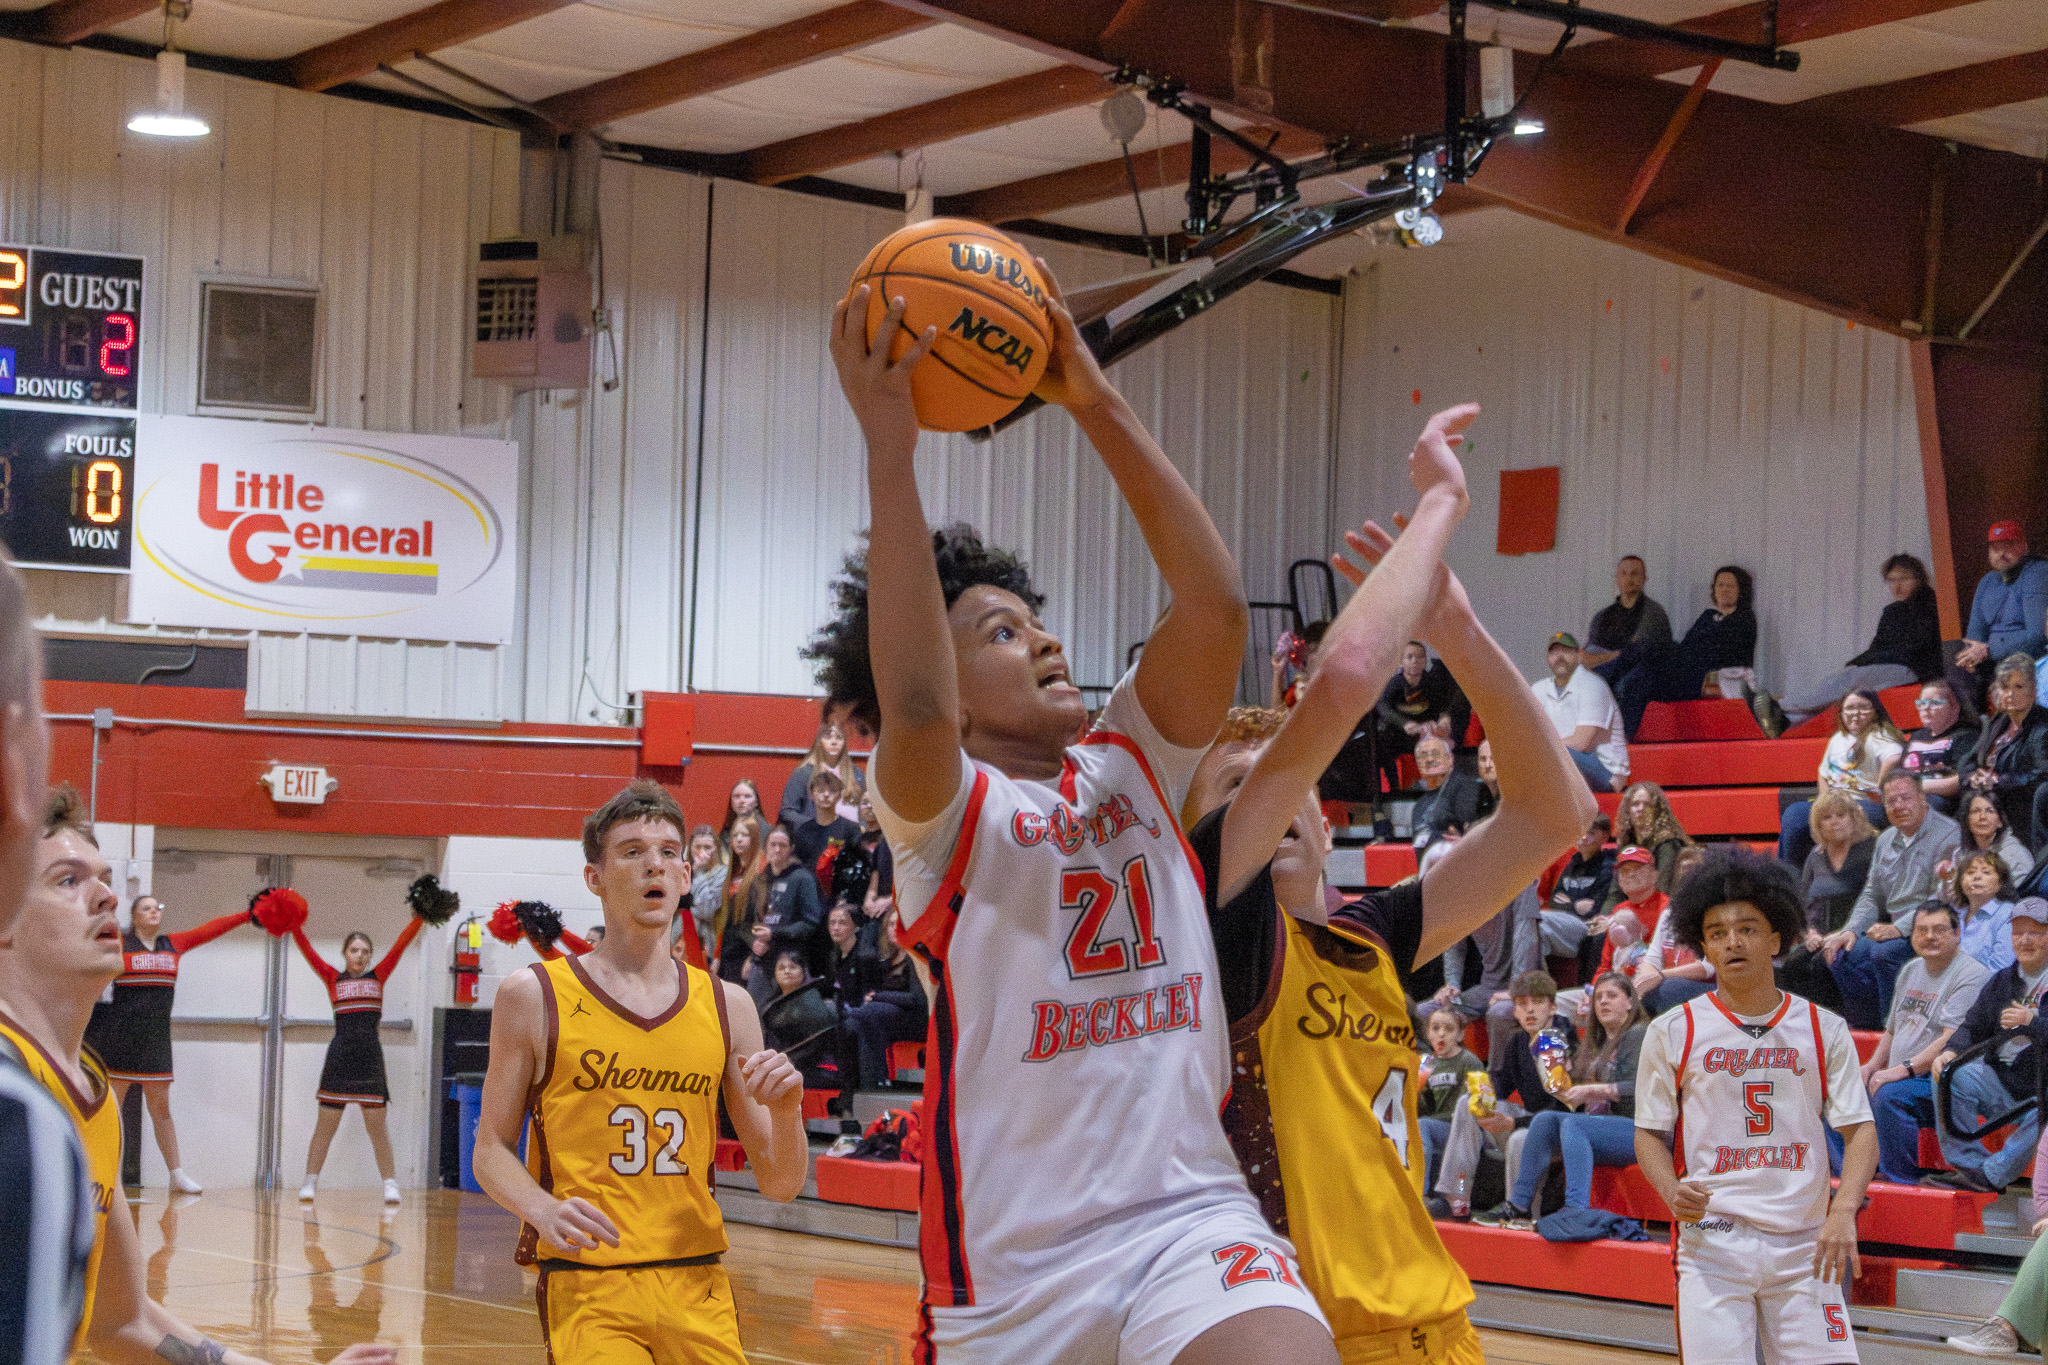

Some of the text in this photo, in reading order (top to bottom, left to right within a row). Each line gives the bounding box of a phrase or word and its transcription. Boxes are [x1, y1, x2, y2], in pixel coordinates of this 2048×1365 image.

[40, 272, 140, 313] GUEST
[948, 243, 1046, 309] Wilso
[100, 314, 135, 376] 2
[948, 306, 1034, 375] NCAA
[15, 376, 84, 400] BONUS
[64, 433, 132, 458] FOULS
[86, 460, 122, 523] 0
[197, 462, 324, 531] Little
[68, 526, 120, 550] WON
[228, 513, 433, 584] General
[284, 769, 319, 797] EXIT
[1059, 853, 1167, 981] 21
[1021, 973, 1203, 1063] BECKLEY
[573, 1048, 712, 1097] Sherman
[1703, 1046, 1807, 1077] GREATER
[1371, 1066, 1410, 1171] 4
[1742, 1081, 1774, 1137] 5
[608, 1104, 690, 1177] 32
[1709, 1142, 1810, 1176] BECKLEY
[1211, 1241, 1306, 1293] 21
[1823, 1303, 1848, 1342] 5
